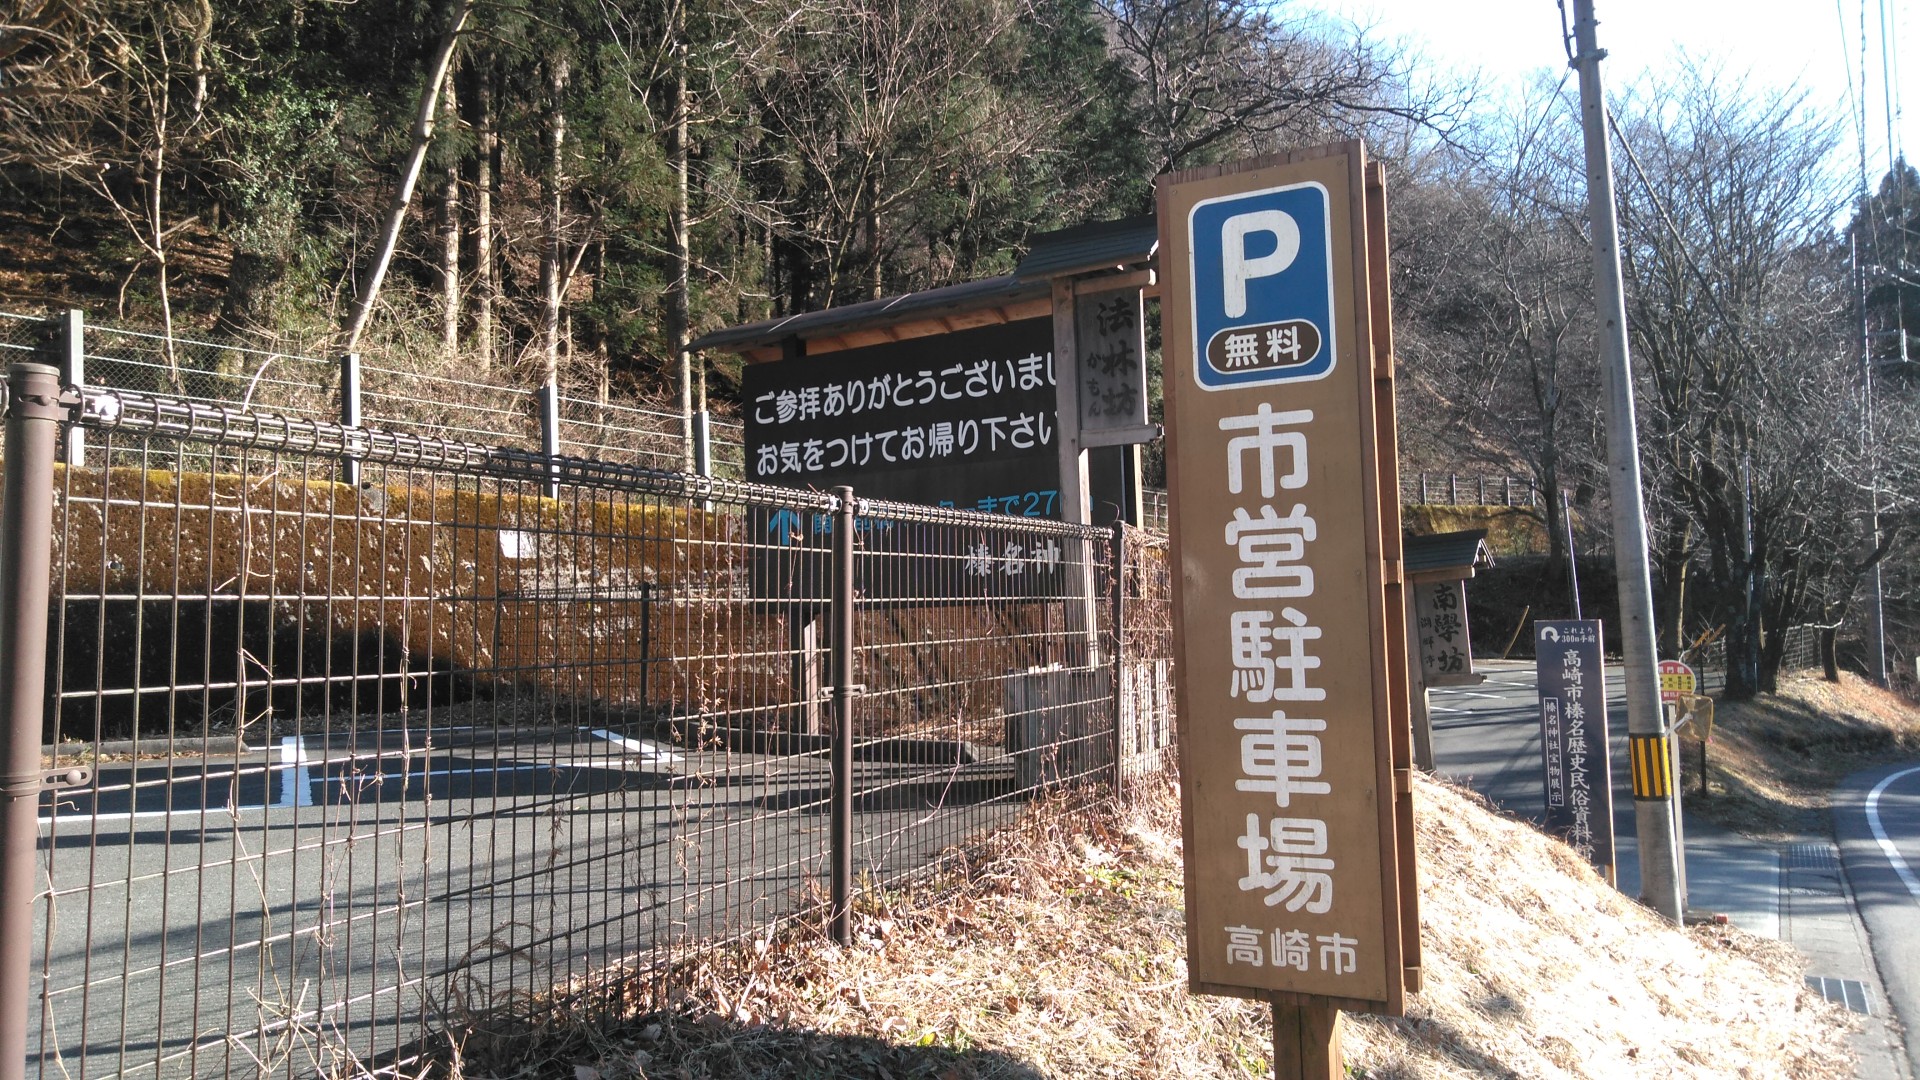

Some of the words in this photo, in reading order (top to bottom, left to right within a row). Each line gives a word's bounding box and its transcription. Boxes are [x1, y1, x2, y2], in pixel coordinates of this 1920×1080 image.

[1221, 209, 1301, 319] P
[755, 353, 1057, 424] ご参拝ありがとうございまし
[1096, 297, 1138, 417] 法林坊
[1223, 325, 1302, 367] 無料
[756, 411, 1058, 475] お気をつけてお帰り下さい
[1218, 402, 1334, 914] 市営駐車場
[1563, 626, 1593, 634] これより
[1546, 701, 1563, 803] 榛名神社宝物展示
[1562, 649, 1596, 860] 高崎市榛名歴史民俗資料館
[1223, 925, 1359, 976] 高崎市
